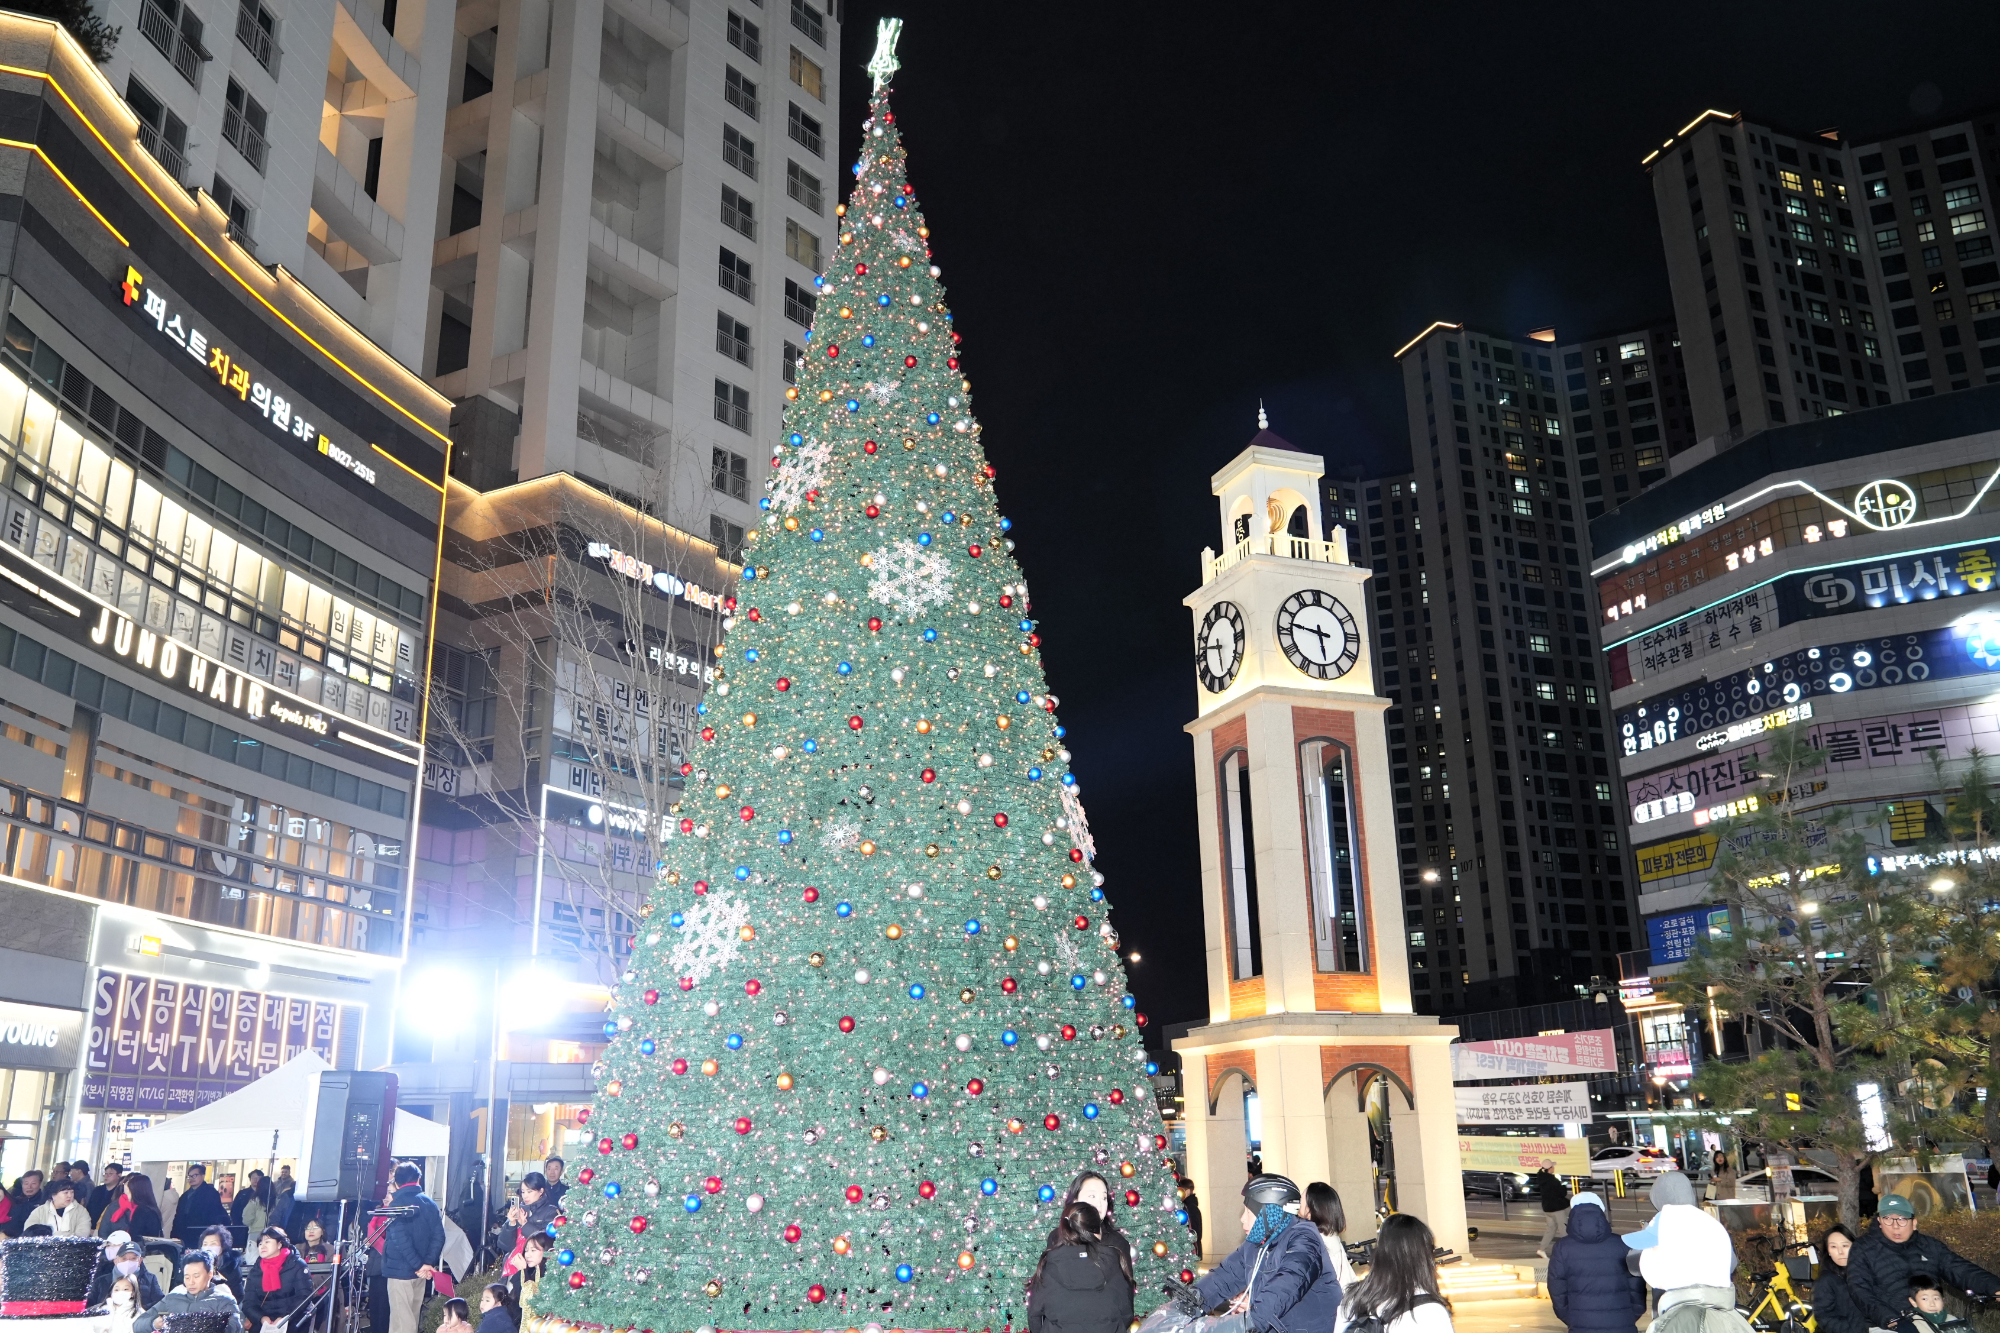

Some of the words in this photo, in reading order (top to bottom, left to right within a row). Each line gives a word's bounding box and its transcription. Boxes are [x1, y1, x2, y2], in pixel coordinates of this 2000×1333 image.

[292, 415, 315, 442] 3F
[328, 443, 376, 484] 8027-2515
[684, 582, 723, 612] Mart
[1704, 593, 1759, 625] 하지정맥
[334, 609, 410, 663] 임플란트
[1642, 622, 1690, 651] 도수치료
[91, 607, 179, 679] JUNO
[189, 655, 266, 717] HAIR
[270, 701, 303, 726] depuis
[304, 713, 328, 735] 1982
[1644, 641, 1694, 671] 척추관절
[1624, 731, 1652, 756] 안과
[1654, 720, 1677, 744] 6F
[212, 797, 375, 906] JUNO
[296, 901, 367, 951] HAIR
[110, 1085, 135, 1102] 직영점
[139, 1088, 165, 1101] KT/LG
